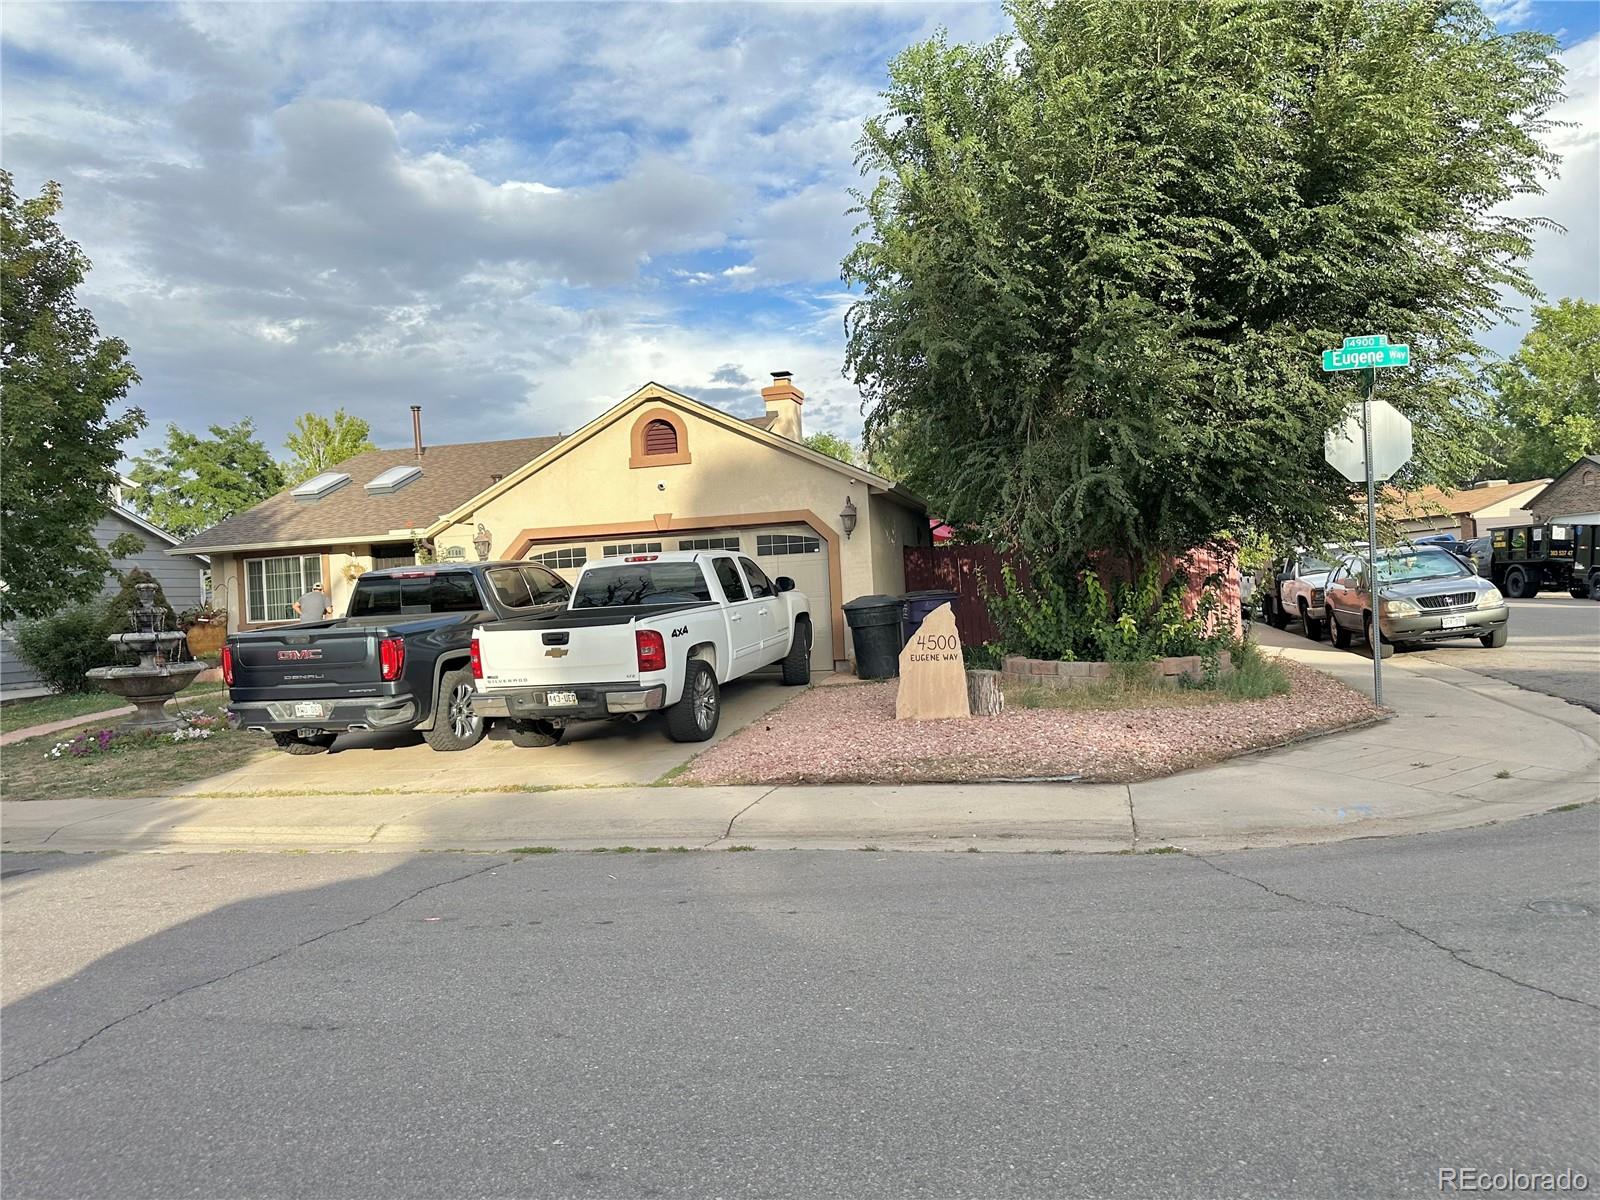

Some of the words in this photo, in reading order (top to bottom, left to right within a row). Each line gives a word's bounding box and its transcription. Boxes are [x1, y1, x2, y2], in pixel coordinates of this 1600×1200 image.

[1346, 338, 1375, 348] 14900
[1379, 337, 1386, 345] E
[1332, 350, 1384, 368] Eugene
[1389, 350, 1406, 360] Way
[917, 634, 957, 651] 4500
[277, 648, 323, 661] GMC
[910, 654, 940, 662] EUGENE
